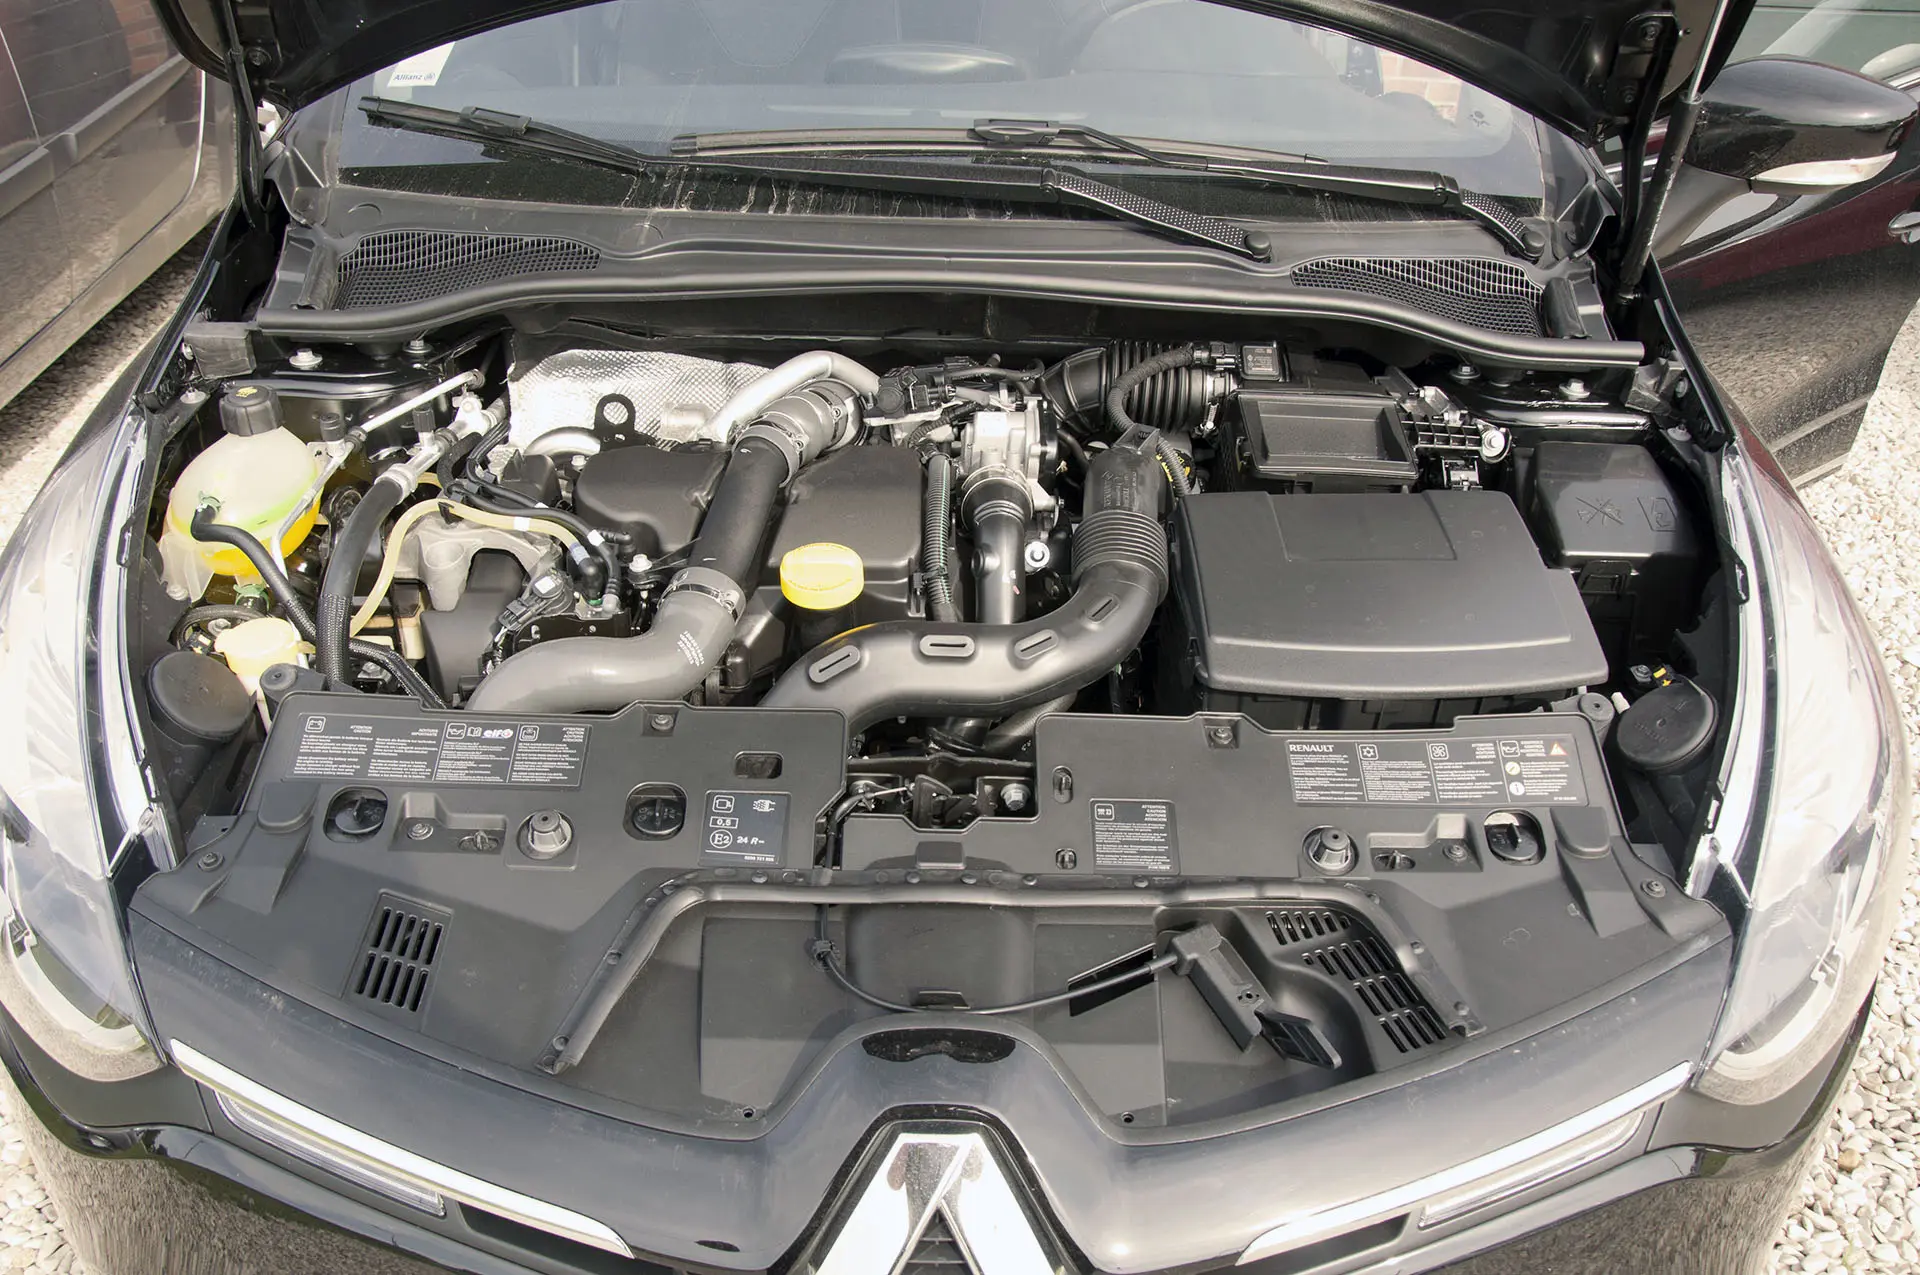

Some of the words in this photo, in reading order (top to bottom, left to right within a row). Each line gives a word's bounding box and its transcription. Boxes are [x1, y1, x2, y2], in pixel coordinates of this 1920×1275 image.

[483, 729, 504, 738] elf
[1289, 744, 1334, 752] RENAULT
[714, 833, 730, 845] E2
[736, 836, 748, 844] 24
